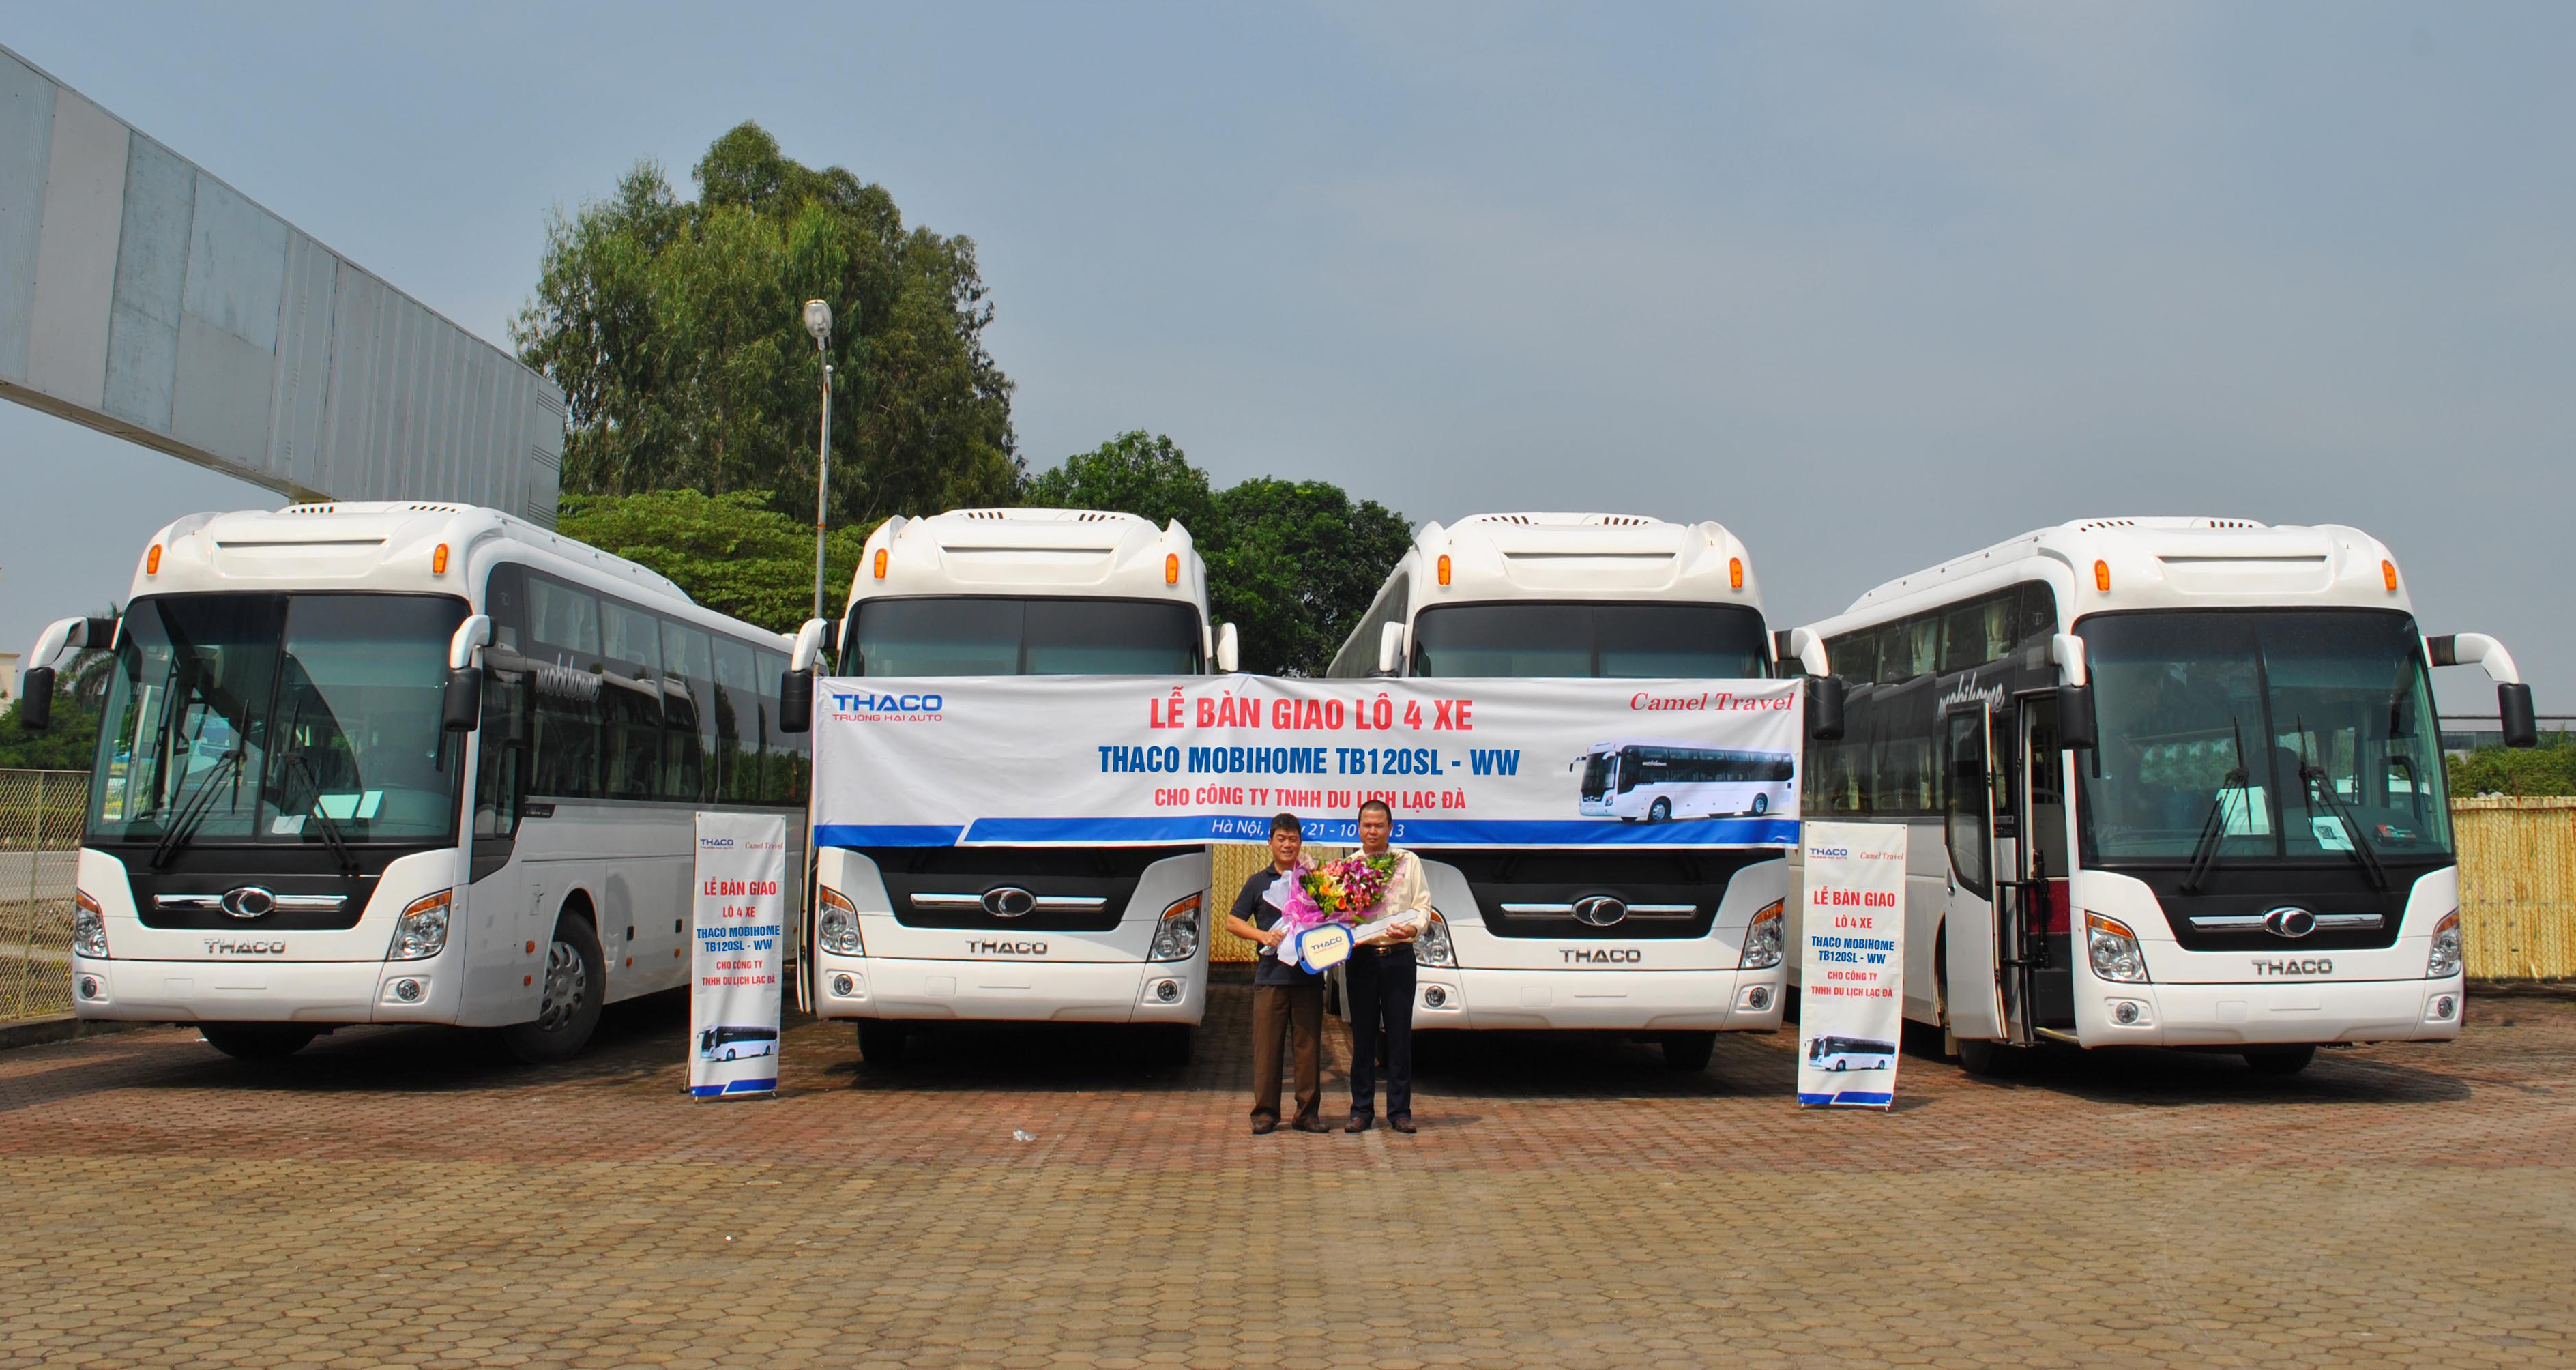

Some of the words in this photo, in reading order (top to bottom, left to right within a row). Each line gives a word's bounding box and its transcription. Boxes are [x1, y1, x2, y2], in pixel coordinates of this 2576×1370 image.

[833, 695, 942, 711] THACO
[1150, 686, 1184, 729] LỄ
[1197, 690, 1260, 729] BÀN
[1272, 699, 1344, 730] GIAO
[1356, 693, 1392, 731] LÔ
[1403, 700, 1422, 731] 4
[1433, 699, 1472, 731] XE
[1630, 692, 1706, 711] Camel
[1714, 692, 1794, 711] Travel
[834, 714, 881, 722] TRUONG
[1098, 746, 1180, 773] THACO
[1188, 746, 1327, 774] MOBIHOME
[1336, 748, 1443, 775] TB120SL
[1470, 748, 1520, 776] WW
[1154, 788, 1190, 806] CHO
[1196, 783, 1243, 806] CÔNG
[1249, 788, 1269, 806] TY
[1276, 789, 1321, 808] TNHH
[1328, 790, 1351, 808] DU
[1403, 791, 1435, 813] LẠC
[1441, 787, 1466, 809] ĐÀ
[1212, 819, 1233, 833] Hà
[1236, 820, 1263, 837] Nội,
[1308, 823, 1325, 836] 21
[1341, 824, 1356, 836] 10
[745, 841, 763, 849] Camel
[1860, 851, 1881, 860] Camel
[1883, 852, 1903, 860] Travel
[705, 877, 717, 896] LỄ
[720, 879, 745, 896] BÀN
[750, 881, 776, 896] GIAO
[1813, 886, 1828, 905] LỄ
[1833, 888, 1860, 906] BÀN
[1864, 892, 1896, 907] GIAO
[723, 905, 734, 918] LÔ
[737, 907, 743, 917] 4
[746, 907, 756, 917] XE
[1835, 915, 1847, 928] LÔ
[1850, 918, 1857, 928] 4
[1860, 918, 1873, 929] XE
[697, 927, 726, 939] THACO
[729, 925, 780, 937] MOBIHOME
[205, 938, 286, 954] THACO
[705, 940, 744, 952] TB120SL
[754, 939, 772, 950] WW
[965, 938, 1048, 955] THACO
[1311, 936, 1342, 950] THACO
[1811, 935, 1841, 948] THACO
[1843, 938, 1894, 951] MOBIHOME
[1559, 947, 1641, 963] THACO
[1819, 950, 1857, 963] TB120SL
[1867, 953, 1886, 965] WW
[716, 961, 731, 970] CHO
[733, 959, 752, 970] CÔNG
[755, 960, 763, 969] TY
[2251, 959, 2332, 975] THACO
[702, 977, 721, 986] TNHH
[723, 977, 732, 985] DU
[733, 976, 750, 987] LỊCH
[752, 976, 765, 986] LẠC
[1827, 971, 1843, 980] CHO
[1845, 970, 1867, 981] CÔNG
[1869, 972, 1877, 981] TY
[1811, 986, 1832, 995] TNHH
[1834, 987, 1844, 996] DU
[1846, 987, 1863, 998] LỊCH
[1866, 988, 1880, 999] LẠC
[1882, 987, 1893, 997] ĐÀ
